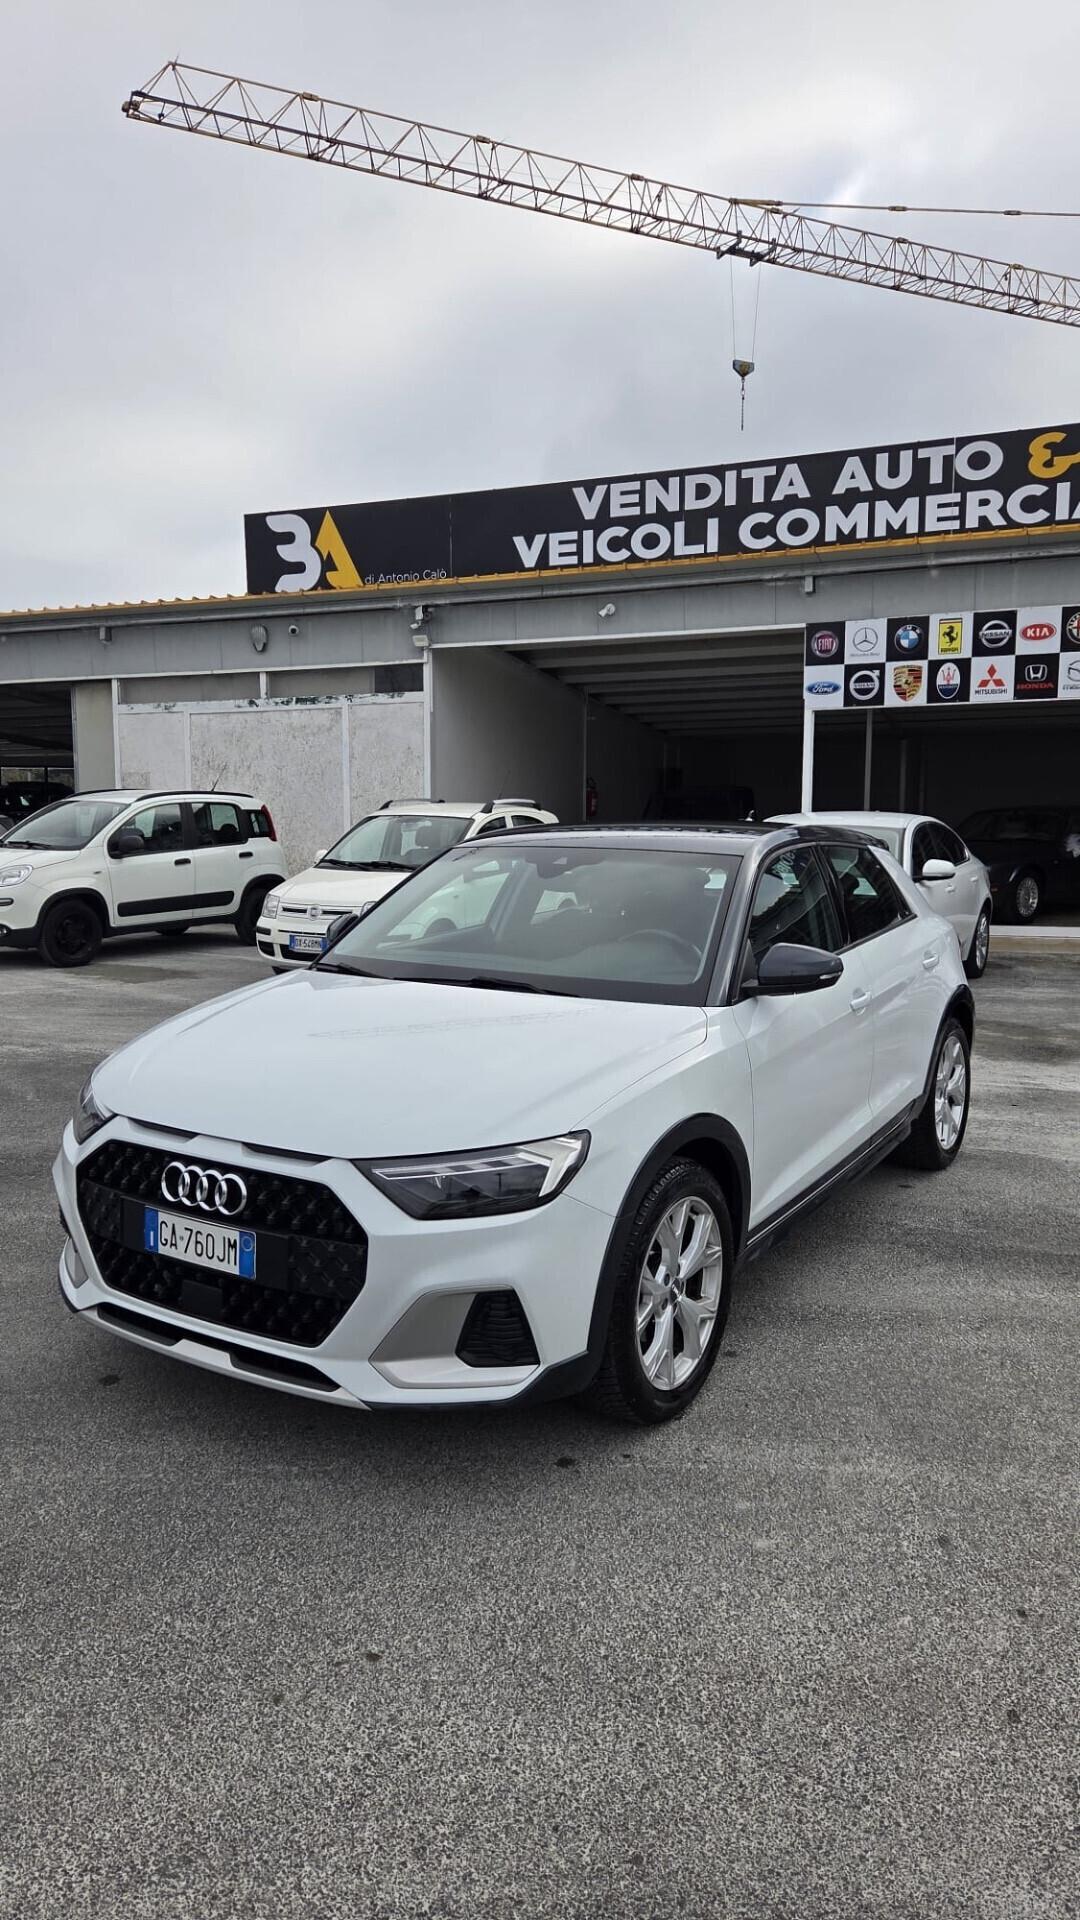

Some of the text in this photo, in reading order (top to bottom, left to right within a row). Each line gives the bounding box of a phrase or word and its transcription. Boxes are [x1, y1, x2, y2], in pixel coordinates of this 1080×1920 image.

[572, 463, 811, 520] VENDITA
[832, 440, 1005, 496] AUTO
[512, 482, 1080, 569] VEICOLI COMMERCI
[364, 568, 447, 585] di Antonio Calò
[981, 631, 1011, 639] NISSAN
[1026, 627, 1050, 637] KIA
[818, 638, 833, 651] FIAT
[812, 682, 834, 693] Ford
[1016, 682, 1055, 690] HONDA
